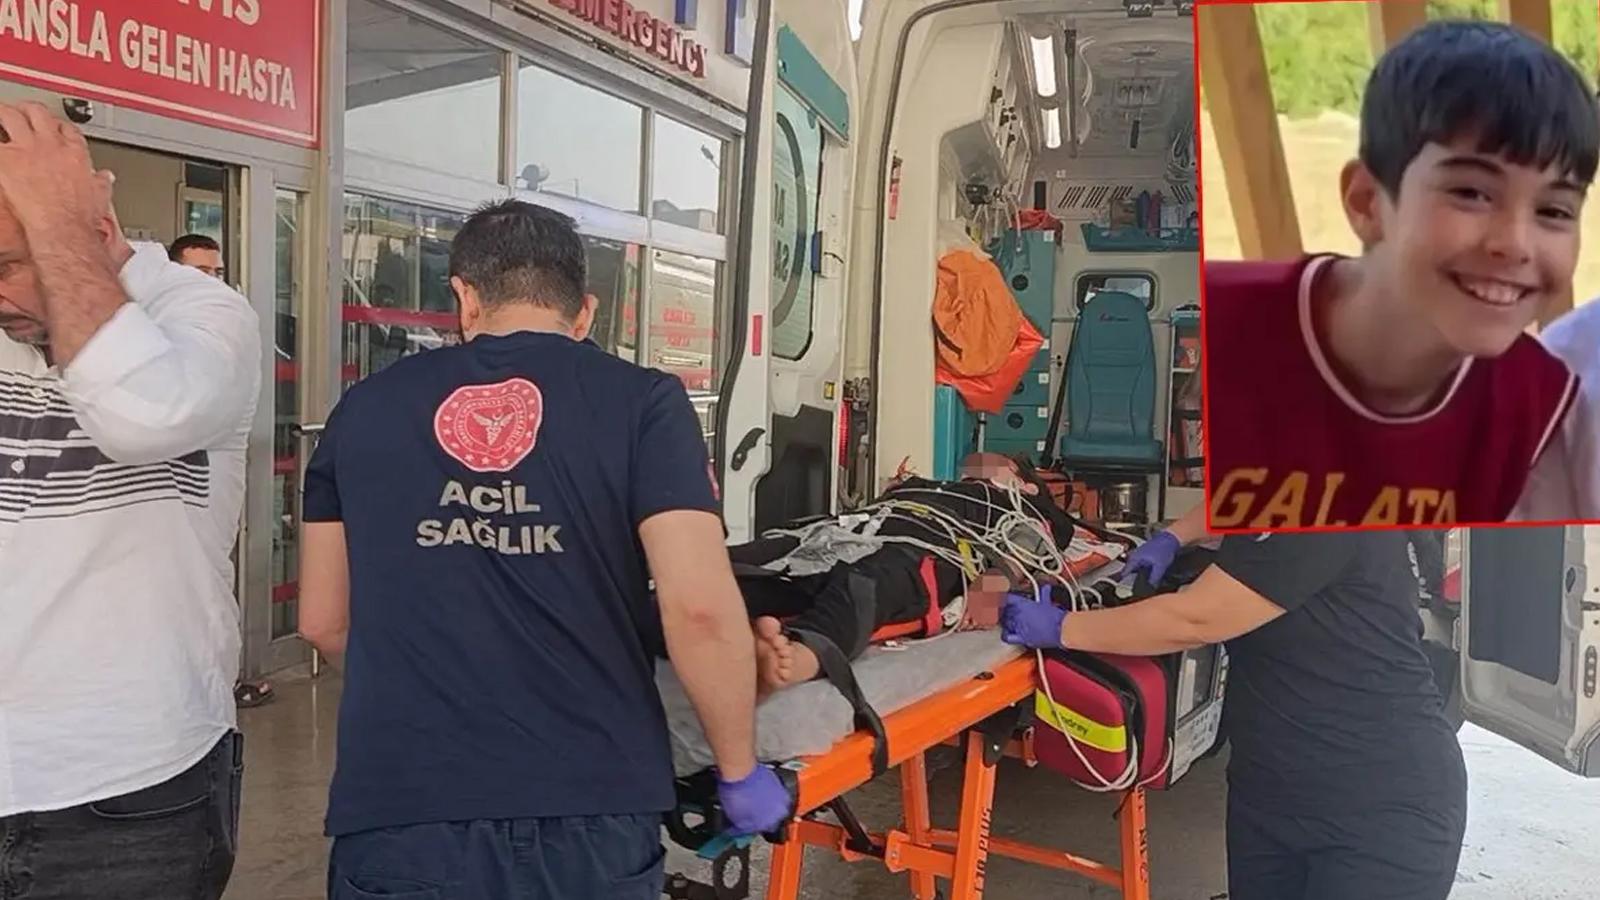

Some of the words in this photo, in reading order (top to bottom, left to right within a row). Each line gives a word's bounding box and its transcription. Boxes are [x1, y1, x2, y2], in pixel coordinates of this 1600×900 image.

[120, 20, 210, 88] GELEN
[218, 48, 296, 109] HASTA
[439, 480, 541, 515] ACİL
[416, 516, 564, 555] SAĞLIK
